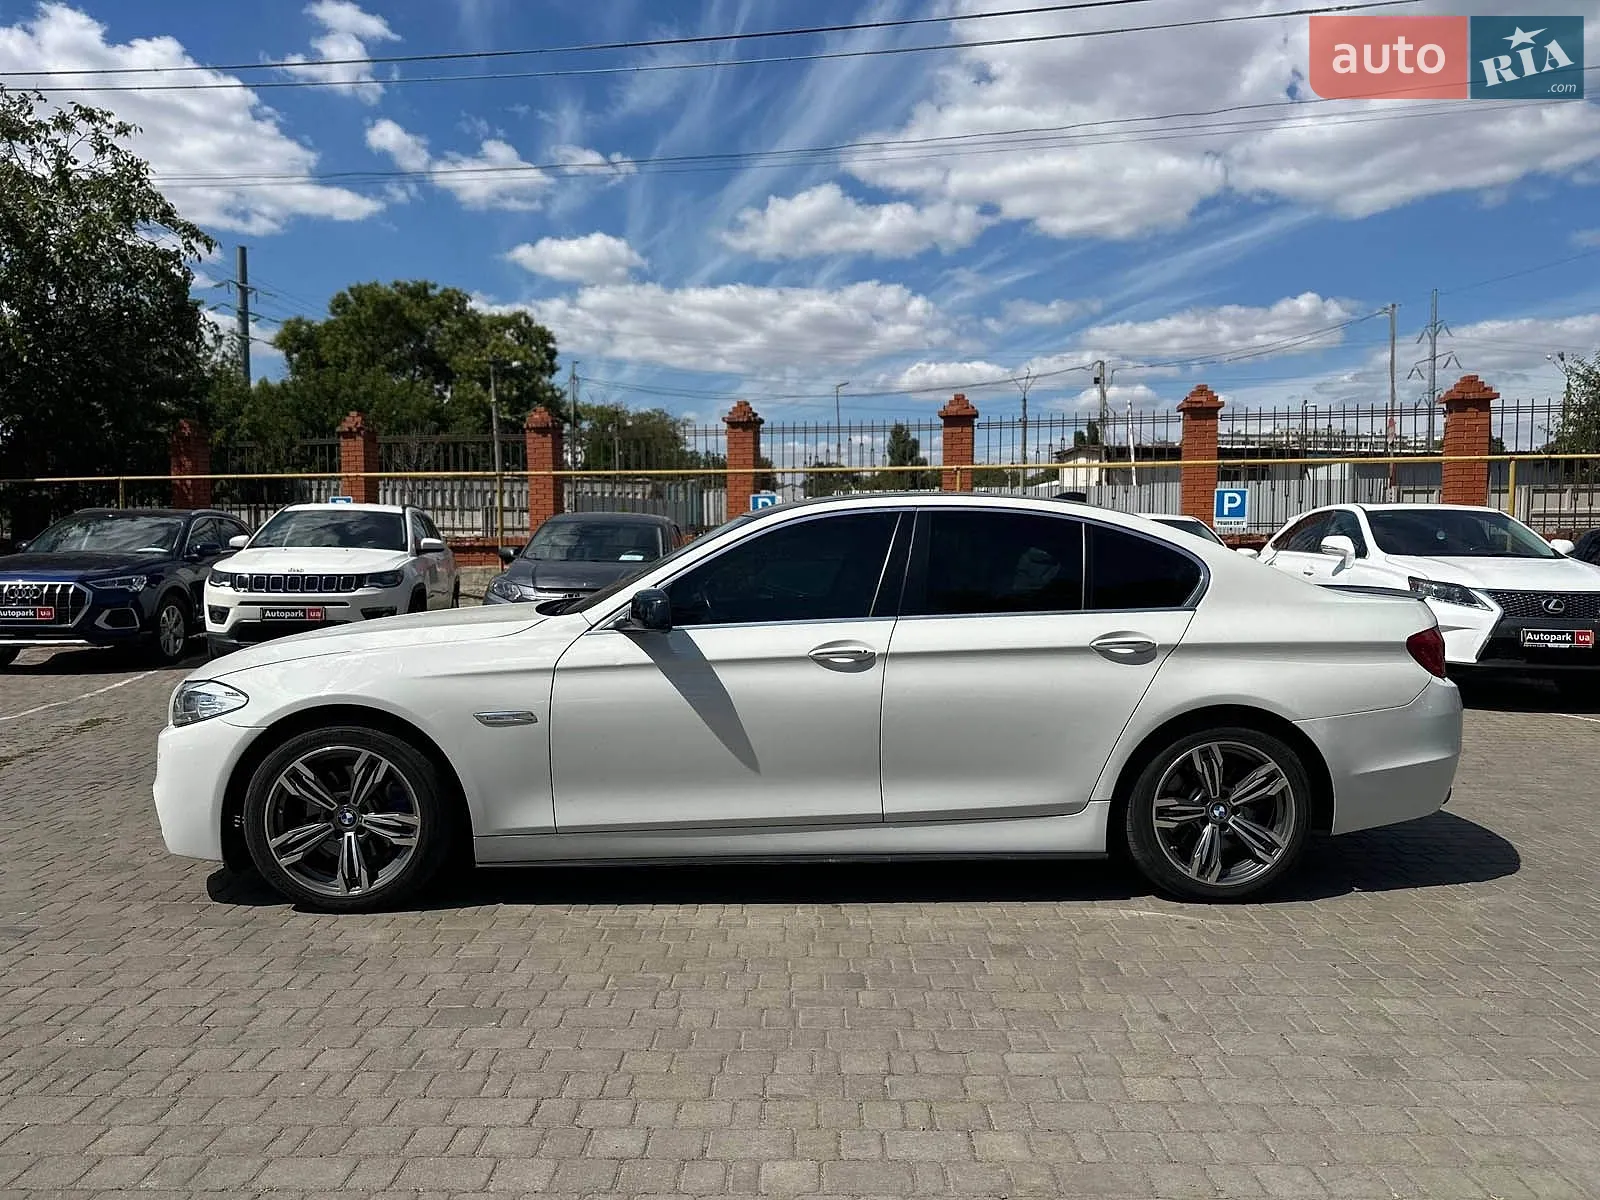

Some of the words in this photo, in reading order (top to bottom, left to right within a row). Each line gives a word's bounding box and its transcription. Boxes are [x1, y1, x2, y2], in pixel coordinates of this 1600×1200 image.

[1223, 492, 1242, 516] P
[264, 610, 304, 619] Autopark
[1526, 632, 1572, 643] Autopark
